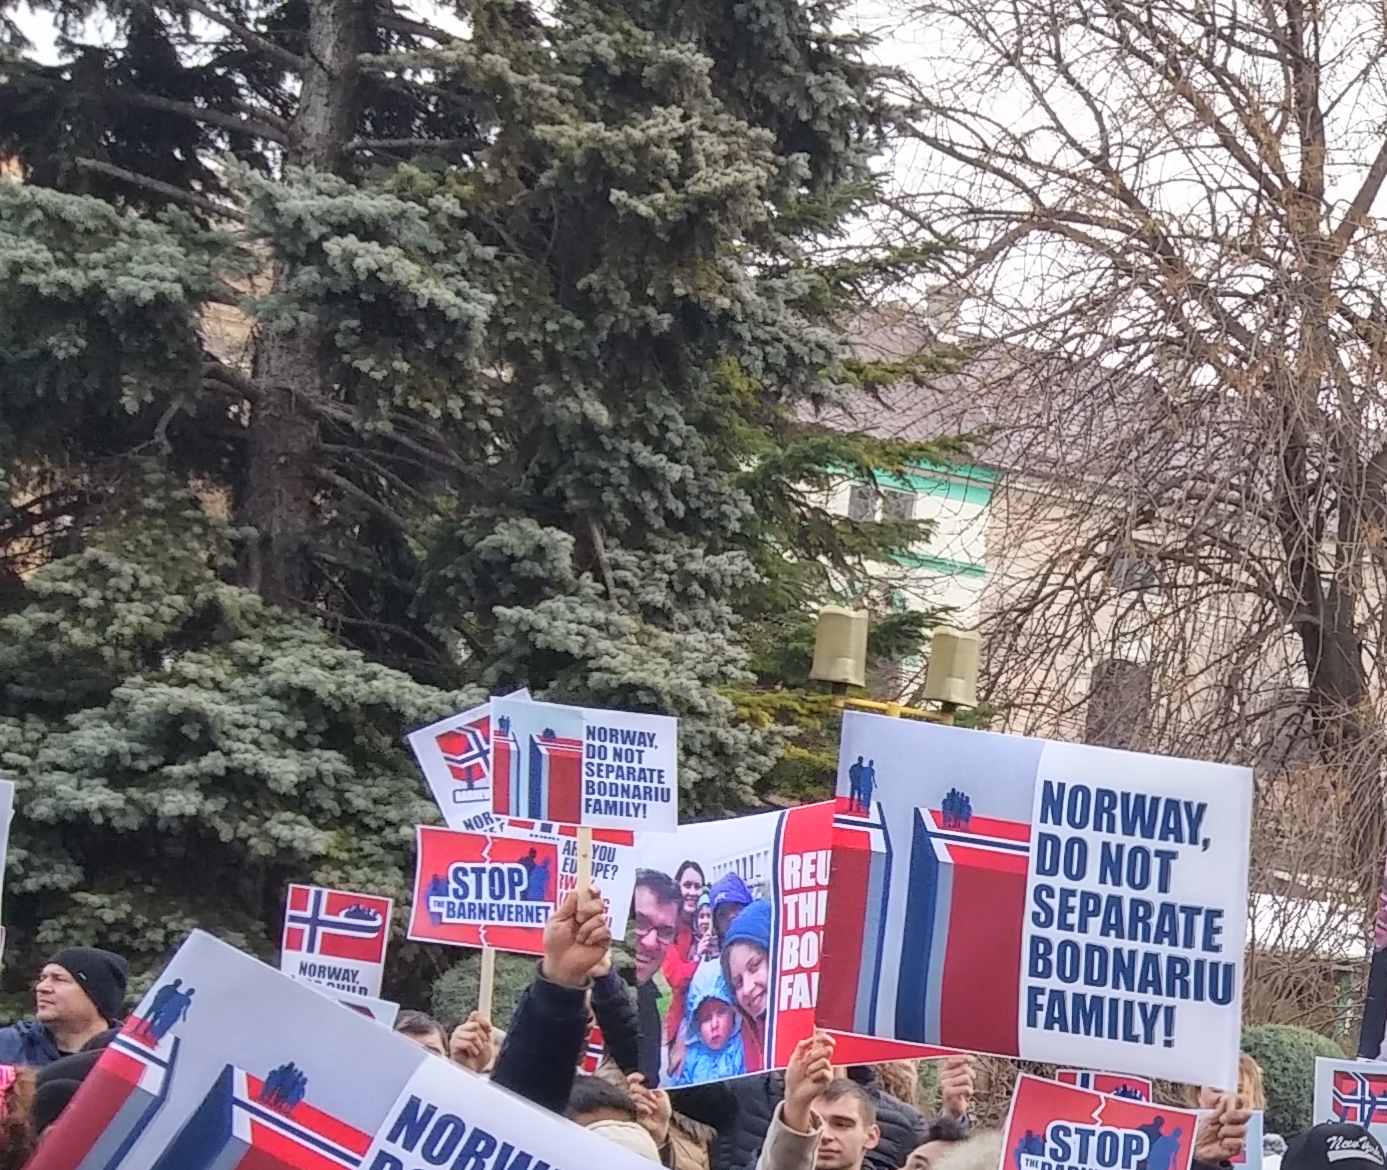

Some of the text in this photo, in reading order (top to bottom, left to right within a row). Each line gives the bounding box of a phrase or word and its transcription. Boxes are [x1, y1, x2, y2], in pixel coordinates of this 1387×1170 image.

[586, 724, 658, 750] NORWAY,
[585, 743, 645, 764] DO NOT
[585, 762, 666, 784] SEPARATE
[585, 780, 671, 802] BODNARIU
[585, 798, 647, 818] FAMILY!
[1040, 780, 1211, 852] NORWAY,
[1036, 833, 1179, 894] DO NOT
[452, 866, 525, 900] STOP
[446, 901, 551, 924] BARNEVERNET
[1032, 885, 1224, 953] SEPARATE
[298, 960, 360, 984] NORWAY,
[1028, 935, 1236, 1006] BODNARIU
[1026, 986, 1176, 1049] FAMILY!
[1050, 1124, 1145, 1170] STOP
[1025, 1157, 1039, 1169] THE
